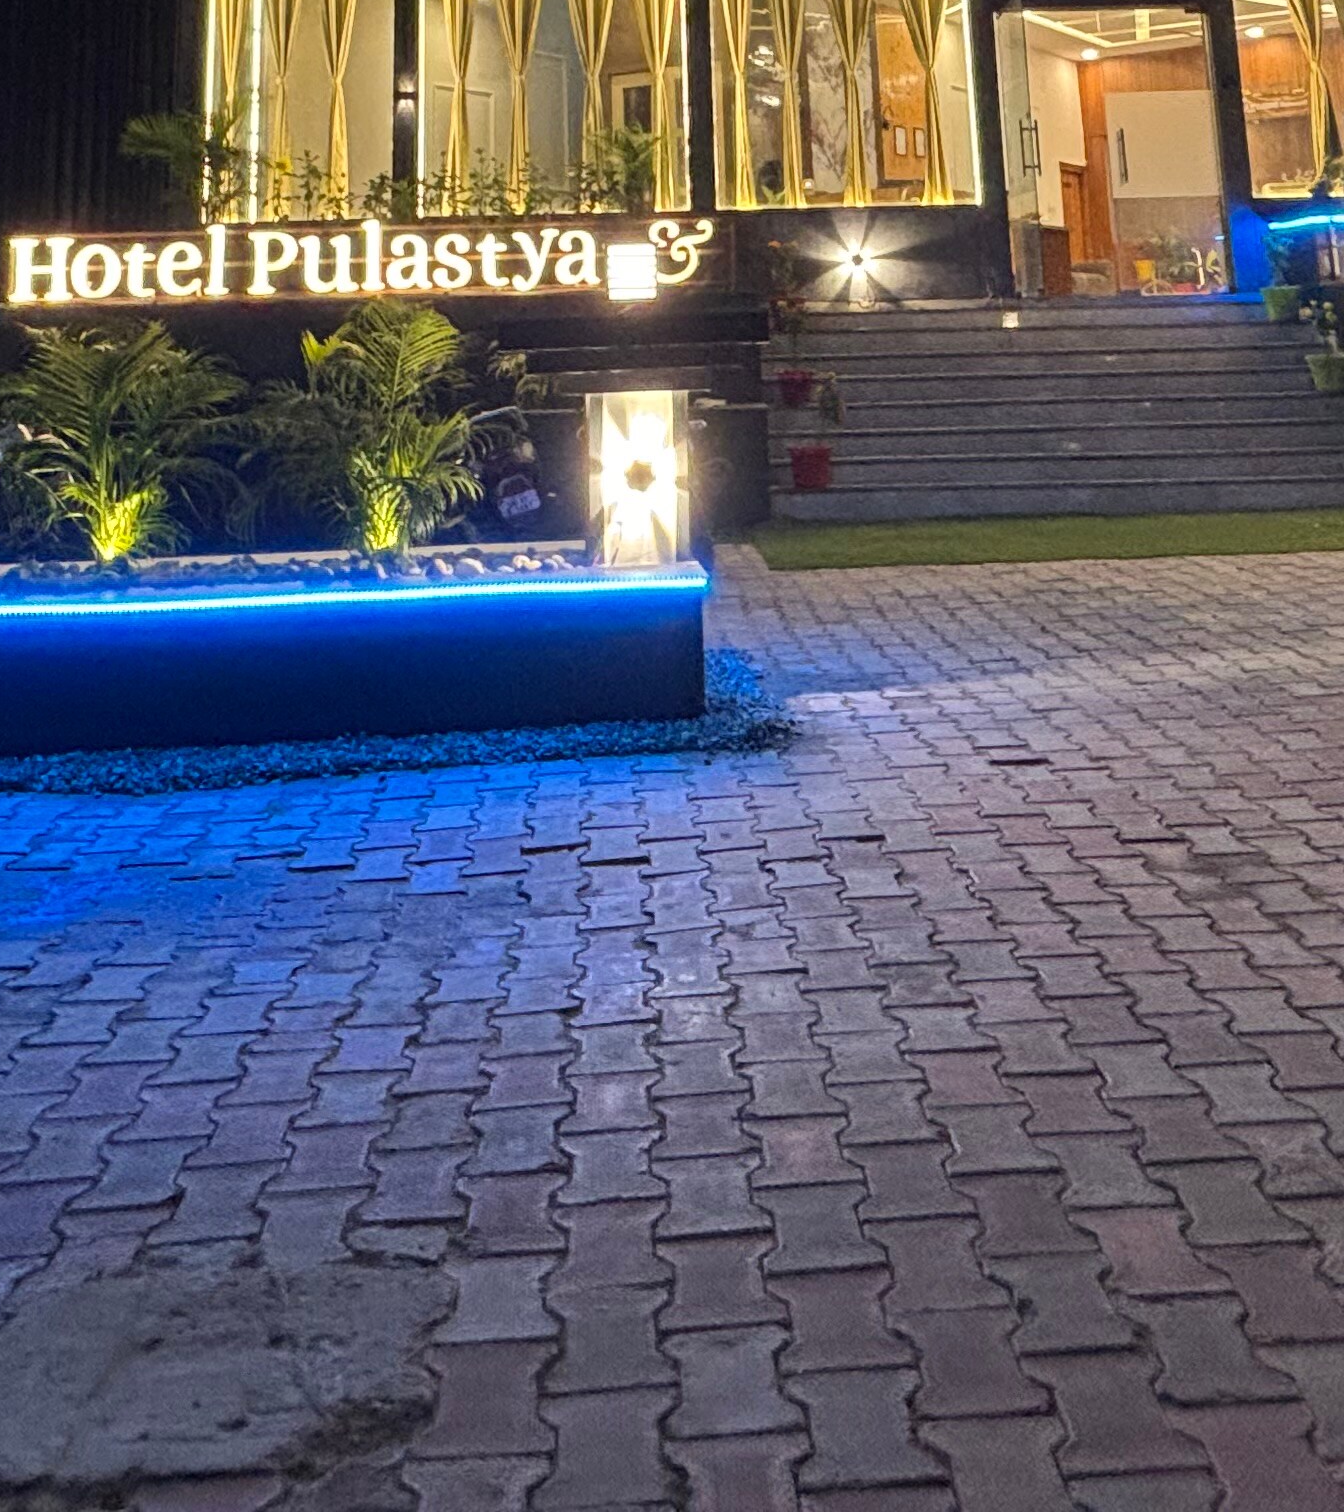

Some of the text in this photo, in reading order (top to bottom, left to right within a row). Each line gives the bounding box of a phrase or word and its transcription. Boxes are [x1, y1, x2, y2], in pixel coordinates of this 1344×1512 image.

[8, 219, 715, 303] Hotel Pulastya &
